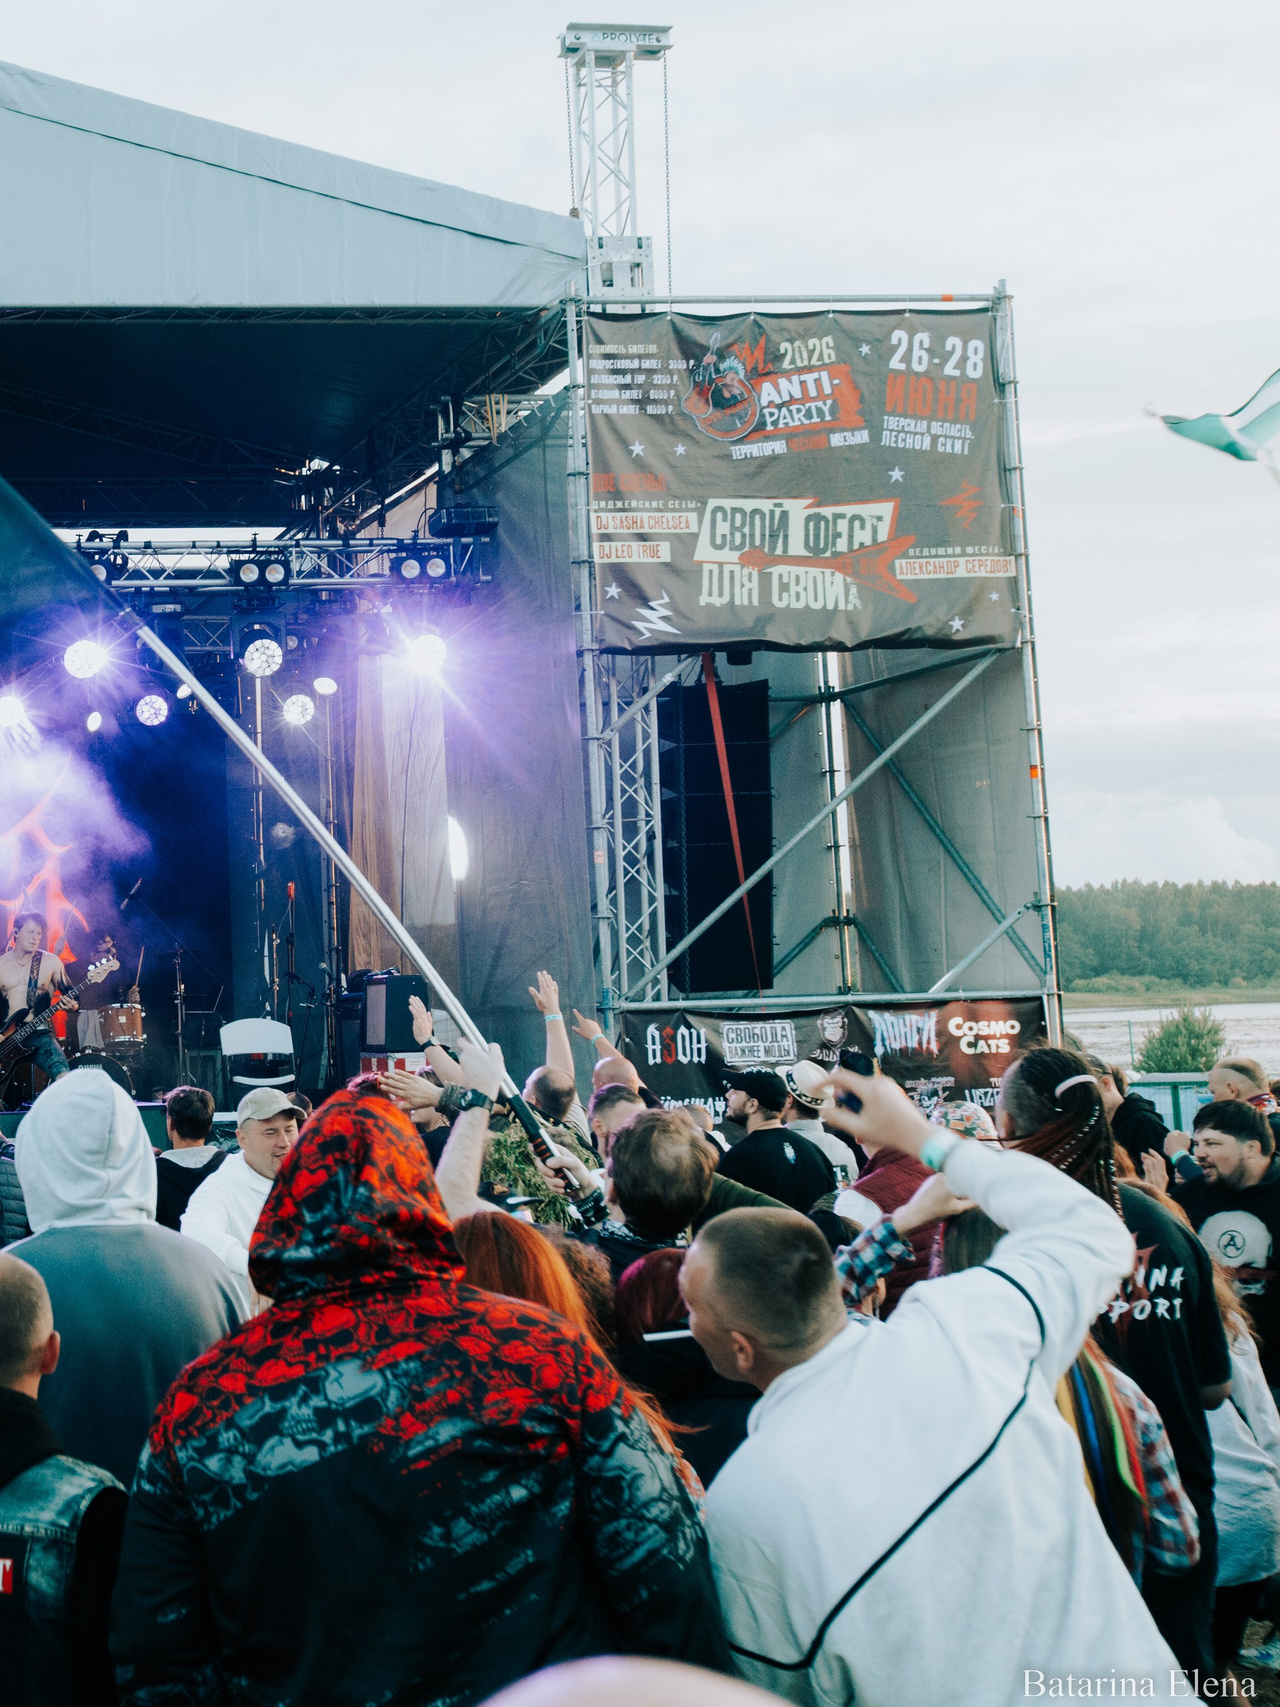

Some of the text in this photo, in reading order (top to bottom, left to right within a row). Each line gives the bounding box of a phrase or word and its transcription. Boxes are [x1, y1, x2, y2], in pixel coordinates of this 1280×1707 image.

[602, 32, 654, 44] PROLYTE
[779, 334, 837, 371] 2026
[888, 329, 985, 379] 26-28
[760, 369, 840, 407] ANTI-
[884, 373, 978, 421] ИЮНЯ
[763, 399, 834, 431] PARTY
[882, 415, 928, 433] ТВЕРСКАЯ
[730, 439, 787, 460] ТЕРРИТОРИЯ
[829, 429, 870, 448] МУЗЫКИ
[880, 430, 970, 455] ЛЕСНОЙ СКИТ
[595, 515, 690, 530] DJ SASHA CHELSEA
[708, 502, 885, 557] СВОЙ ФЕСТ
[598, 544, 661, 559] DJ LEO TRUE
[908, 545, 961, 556] ВЕДУЩИЙ
[898, 558, 1012, 576] АЛЕКСАНДР СЕРЕДОВ!
[698, 563, 759, 607] ДЛЯ
[726, 1025, 789, 1045] СВОБОДА
[948, 1016, 1021, 1038] COSMO
[728, 1044, 762, 1060] ВАЖНЕЕ
[763, 1043, 791, 1059] МОДЫ
[960, 1035, 1011, 1055] CATS
